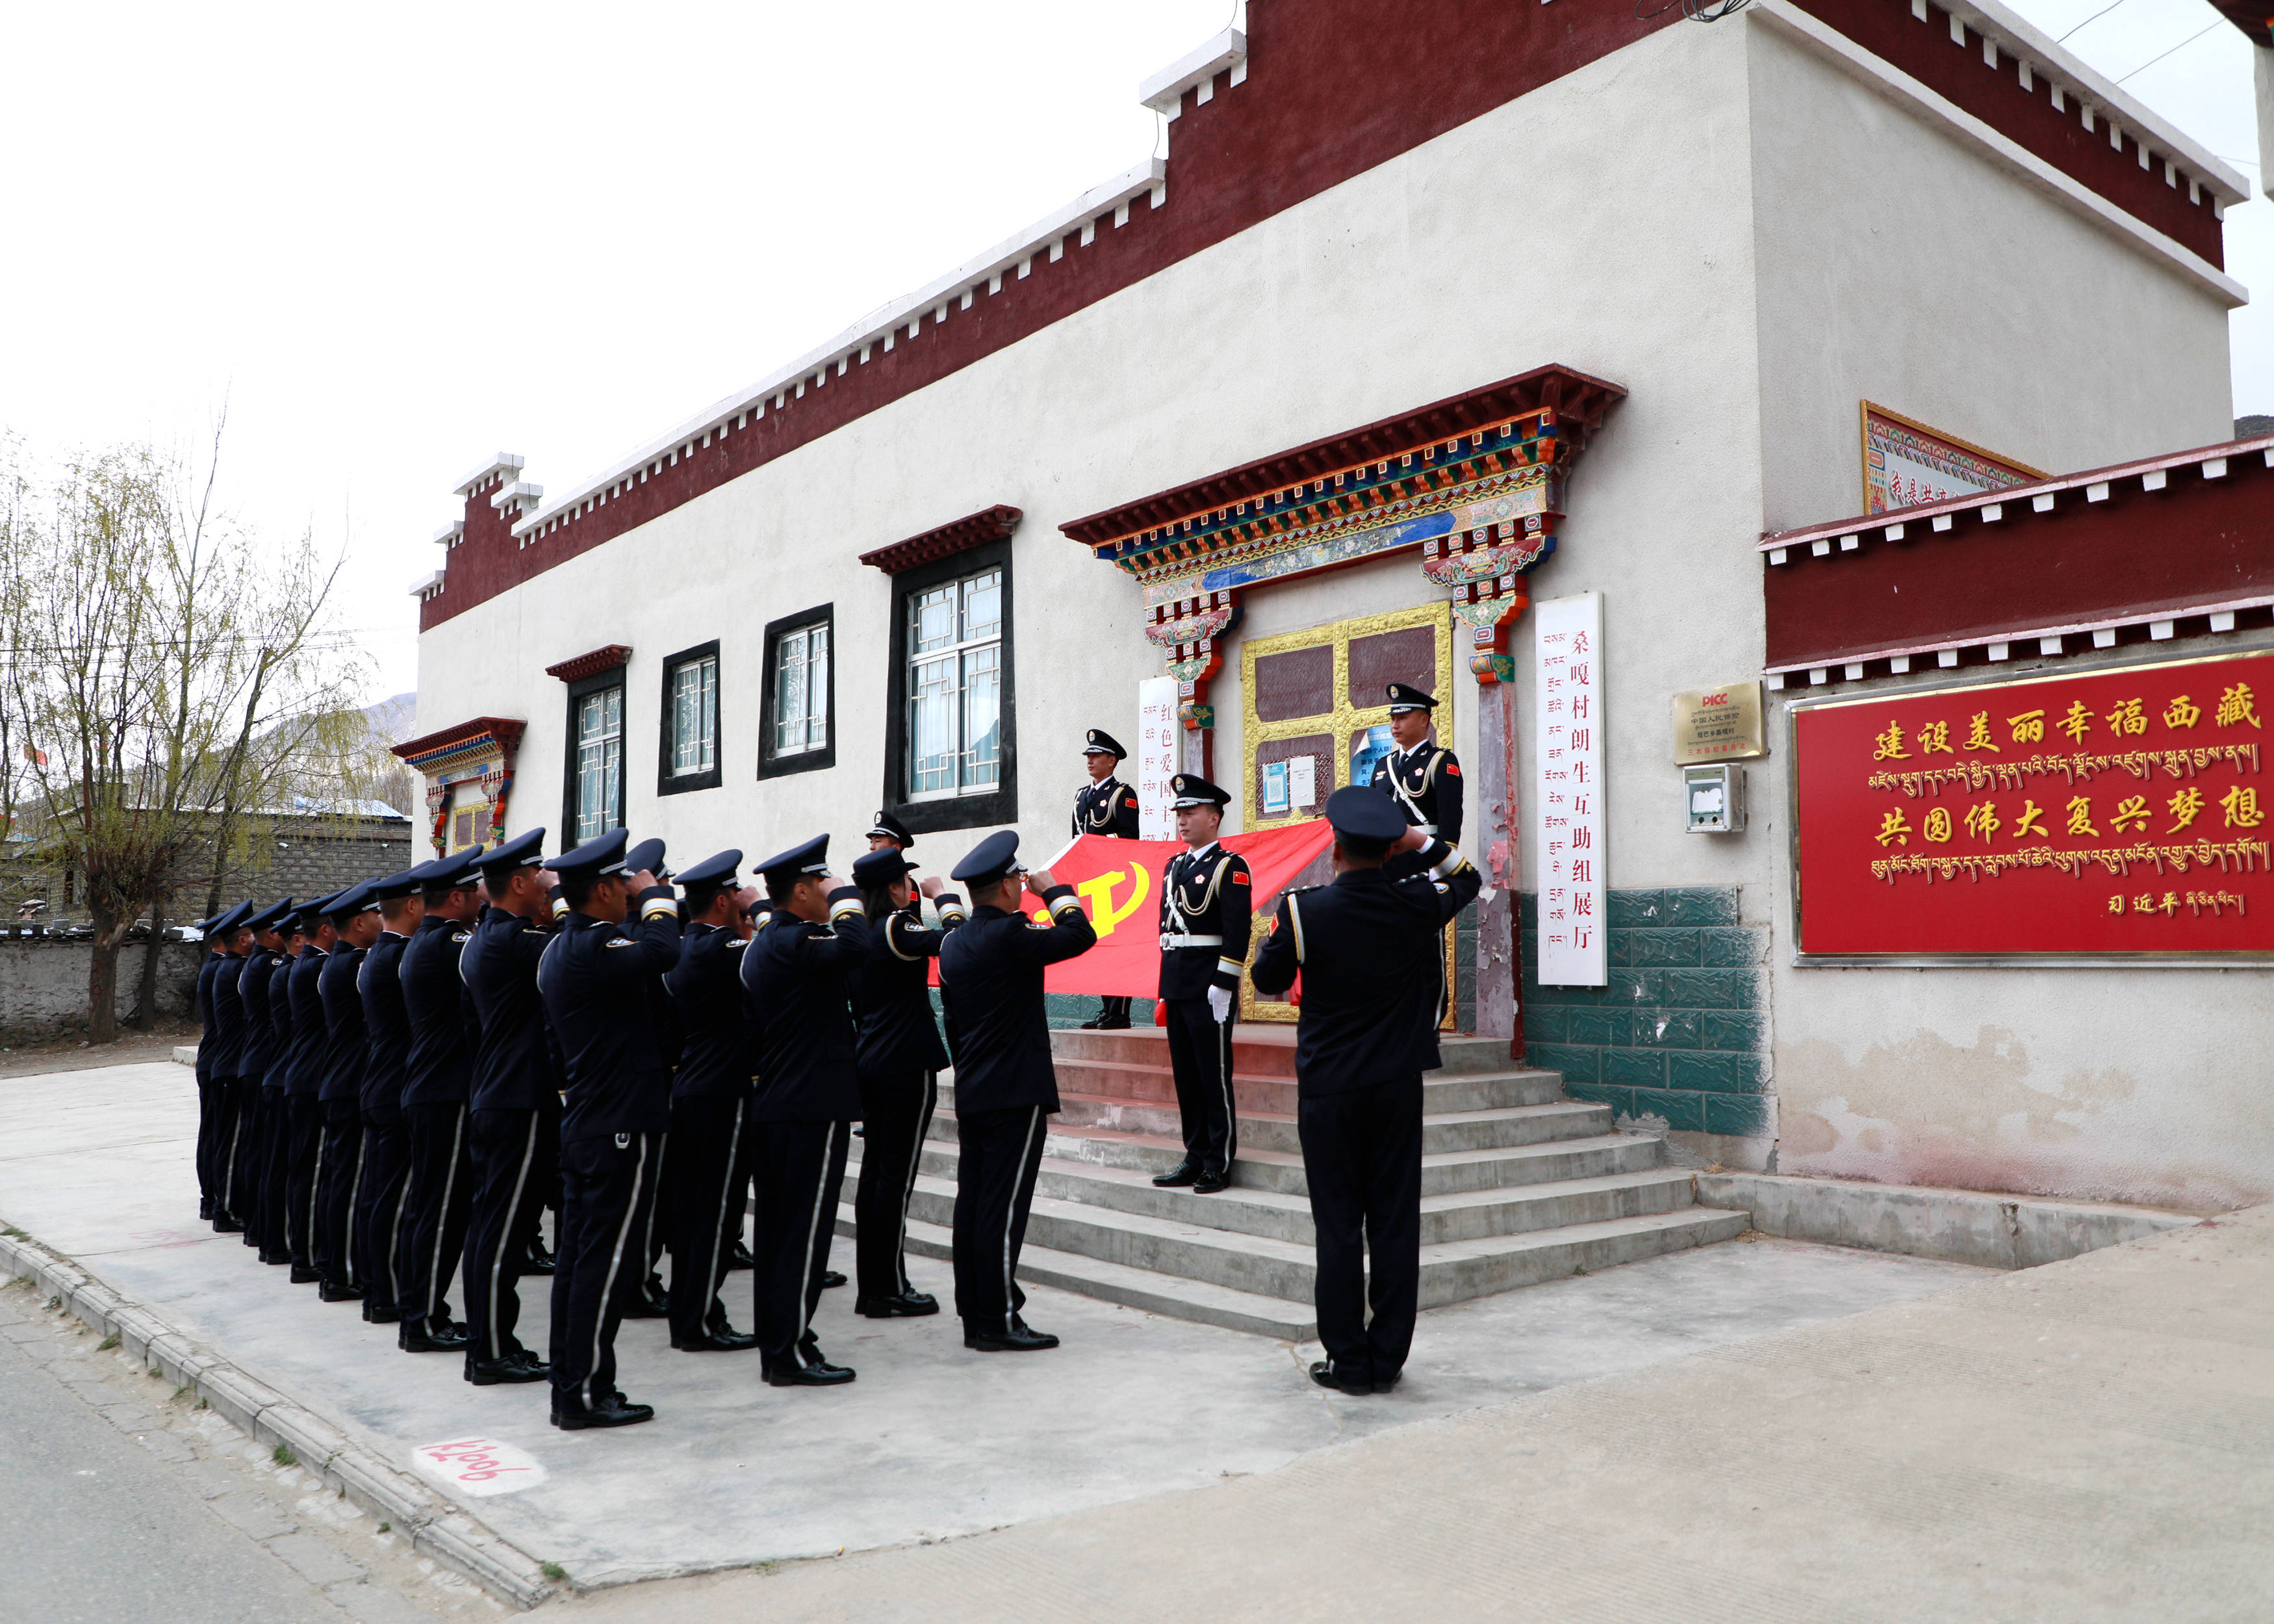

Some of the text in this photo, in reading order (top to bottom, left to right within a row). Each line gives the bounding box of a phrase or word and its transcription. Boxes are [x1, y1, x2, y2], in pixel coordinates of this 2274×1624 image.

[1691, 712, 1740, 724] 中国人民保险
[1702, 692, 1729, 707] PICC
[1872, 681, 2262, 761] 建设美丽幸福西藏
[1570, 630, 1592, 949] 桑嘎村朗生互助组展厅
[1874, 785, 2265, 848] 共圆伟大复兴梦想
[2108, 891, 2180, 917] 习近平
[418, 1439, 533, 1482] K1006
